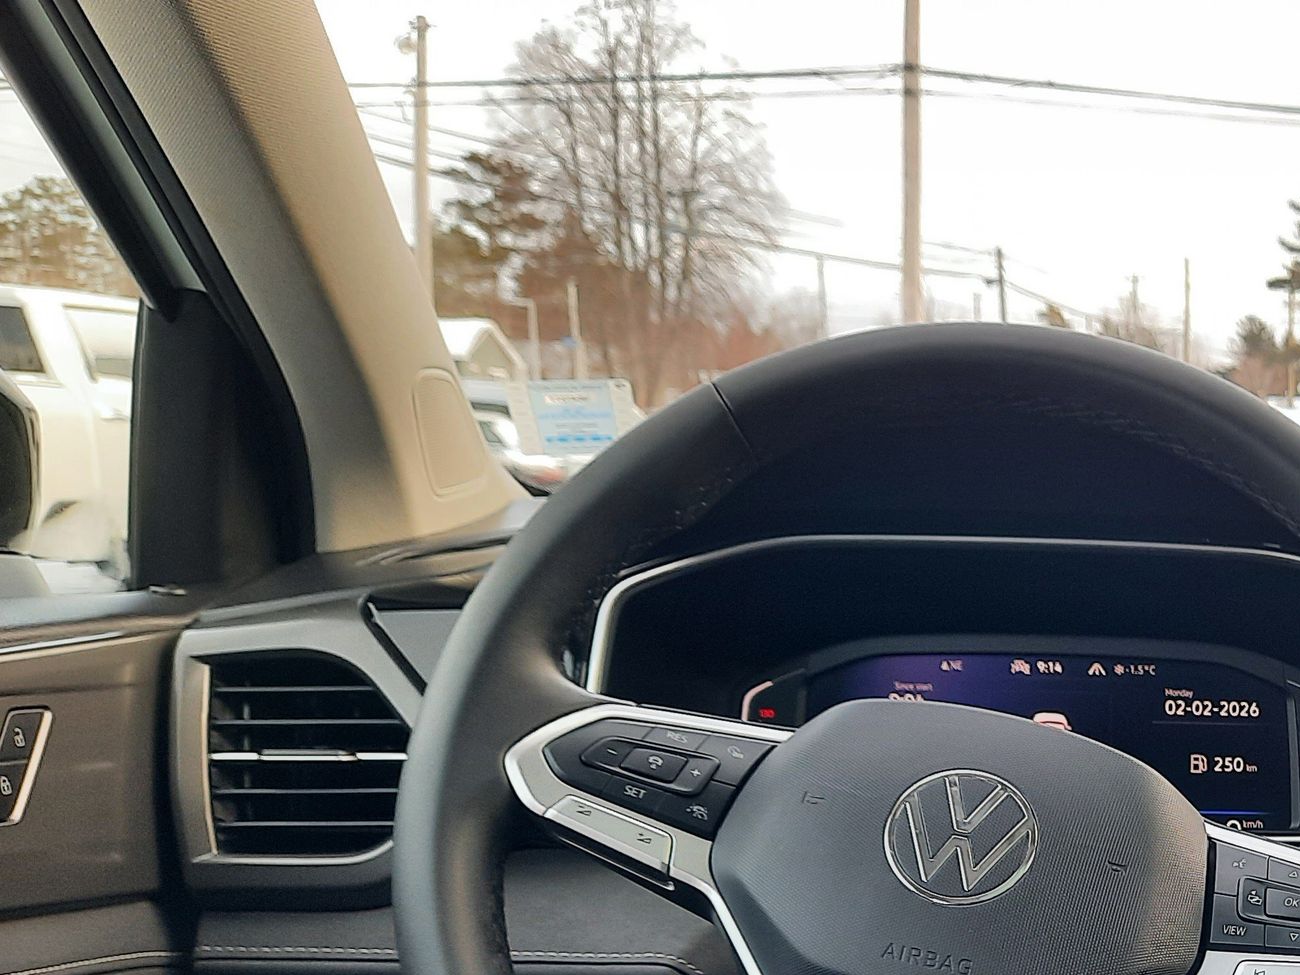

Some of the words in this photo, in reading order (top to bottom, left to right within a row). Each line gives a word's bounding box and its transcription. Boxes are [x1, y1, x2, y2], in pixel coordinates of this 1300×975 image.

[1165, 688, 1194, 699] Monday
[1164, 700, 1260, 717] 02-02-2026
[666, 730, 688, 743] RES
[1214, 757, 1244, 772] 250
[624, 786, 647, 799] SET
[1242, 820, 1263, 829] km/h
[1284, 897, 1300, 908] OK
[1222, 924, 1247, 937] VIEW
